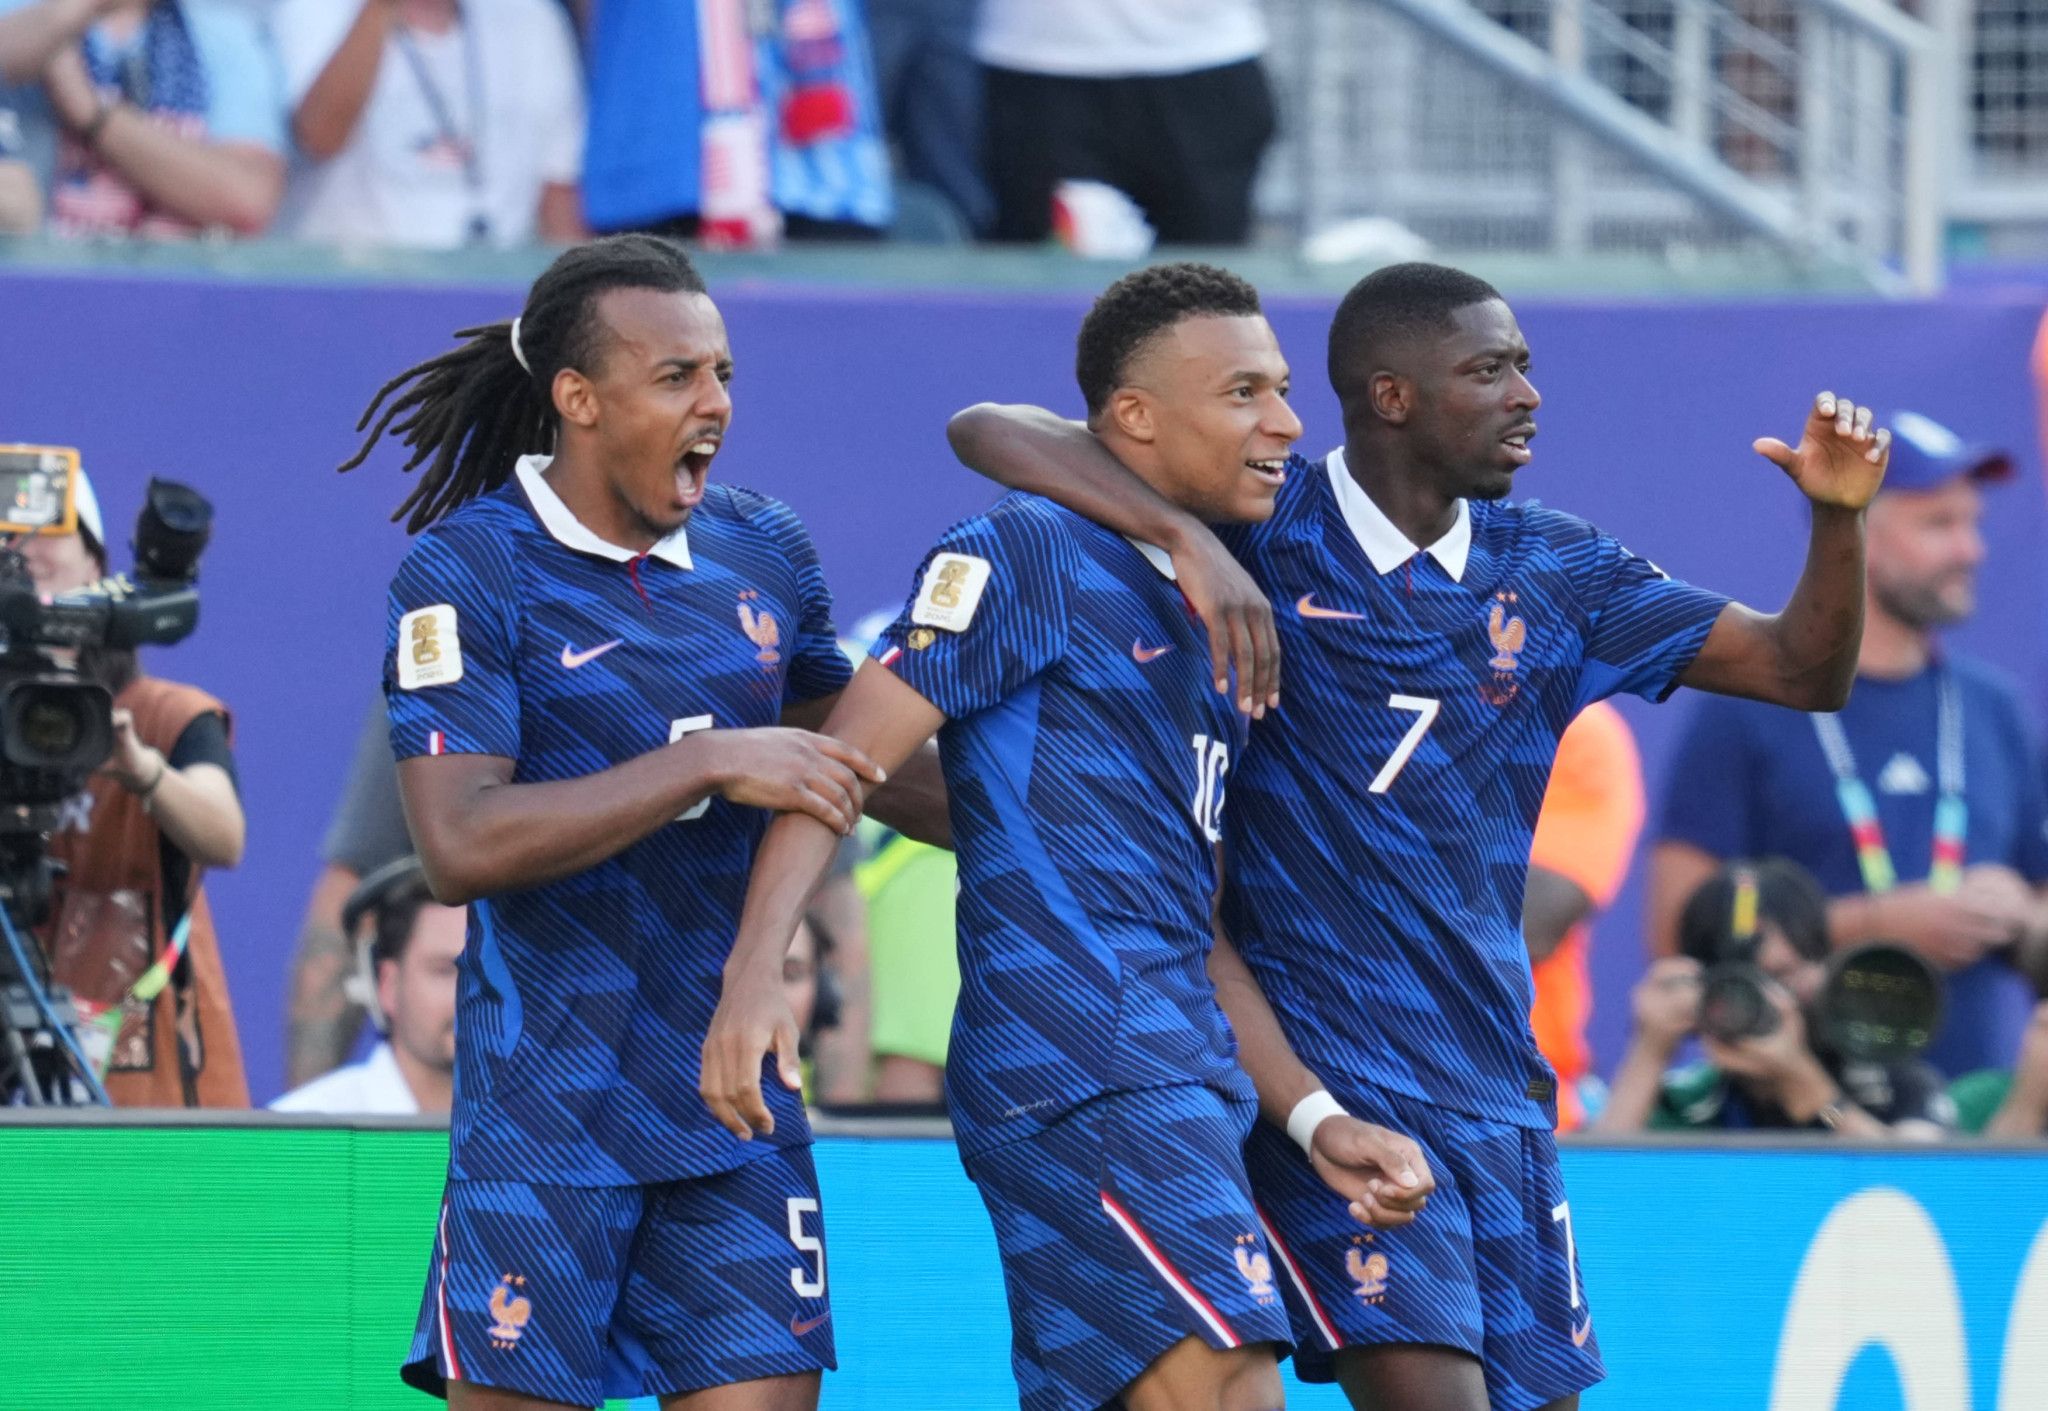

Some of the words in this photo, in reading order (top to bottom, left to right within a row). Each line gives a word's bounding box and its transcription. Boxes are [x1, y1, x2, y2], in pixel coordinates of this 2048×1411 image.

[1192, 733, 1229, 843] 10
[1368, 693, 1440, 793] 7
[786, 1197, 825, 1298] 5
